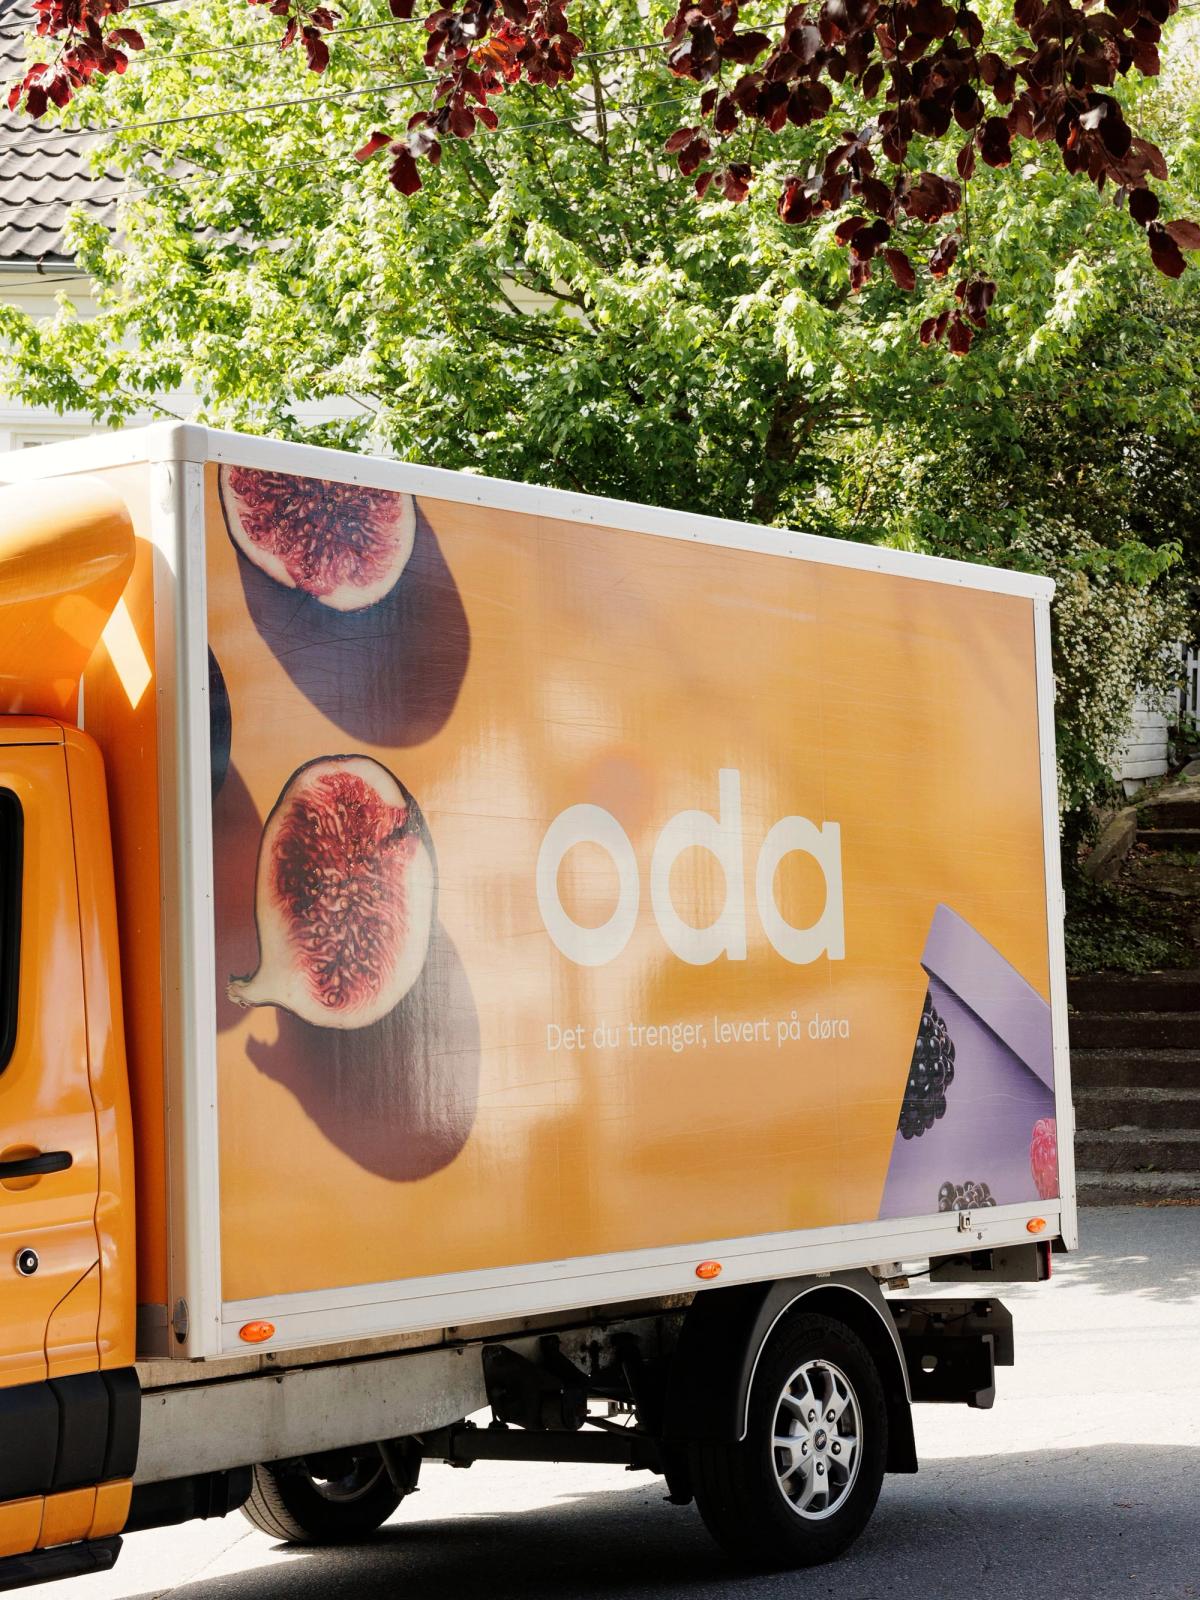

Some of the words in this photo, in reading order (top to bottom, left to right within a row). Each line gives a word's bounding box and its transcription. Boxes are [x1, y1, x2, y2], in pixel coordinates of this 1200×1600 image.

[536, 768, 845, 967] oda
[547, 1023, 585, 1050] Det
[593, 1021, 620, 1049] du
[628, 1022, 707, 1053] trenger,
[714, 1015, 770, 1043] levert
[777, 1010, 800, 1048] på
[808, 1012, 849, 1039] døra
